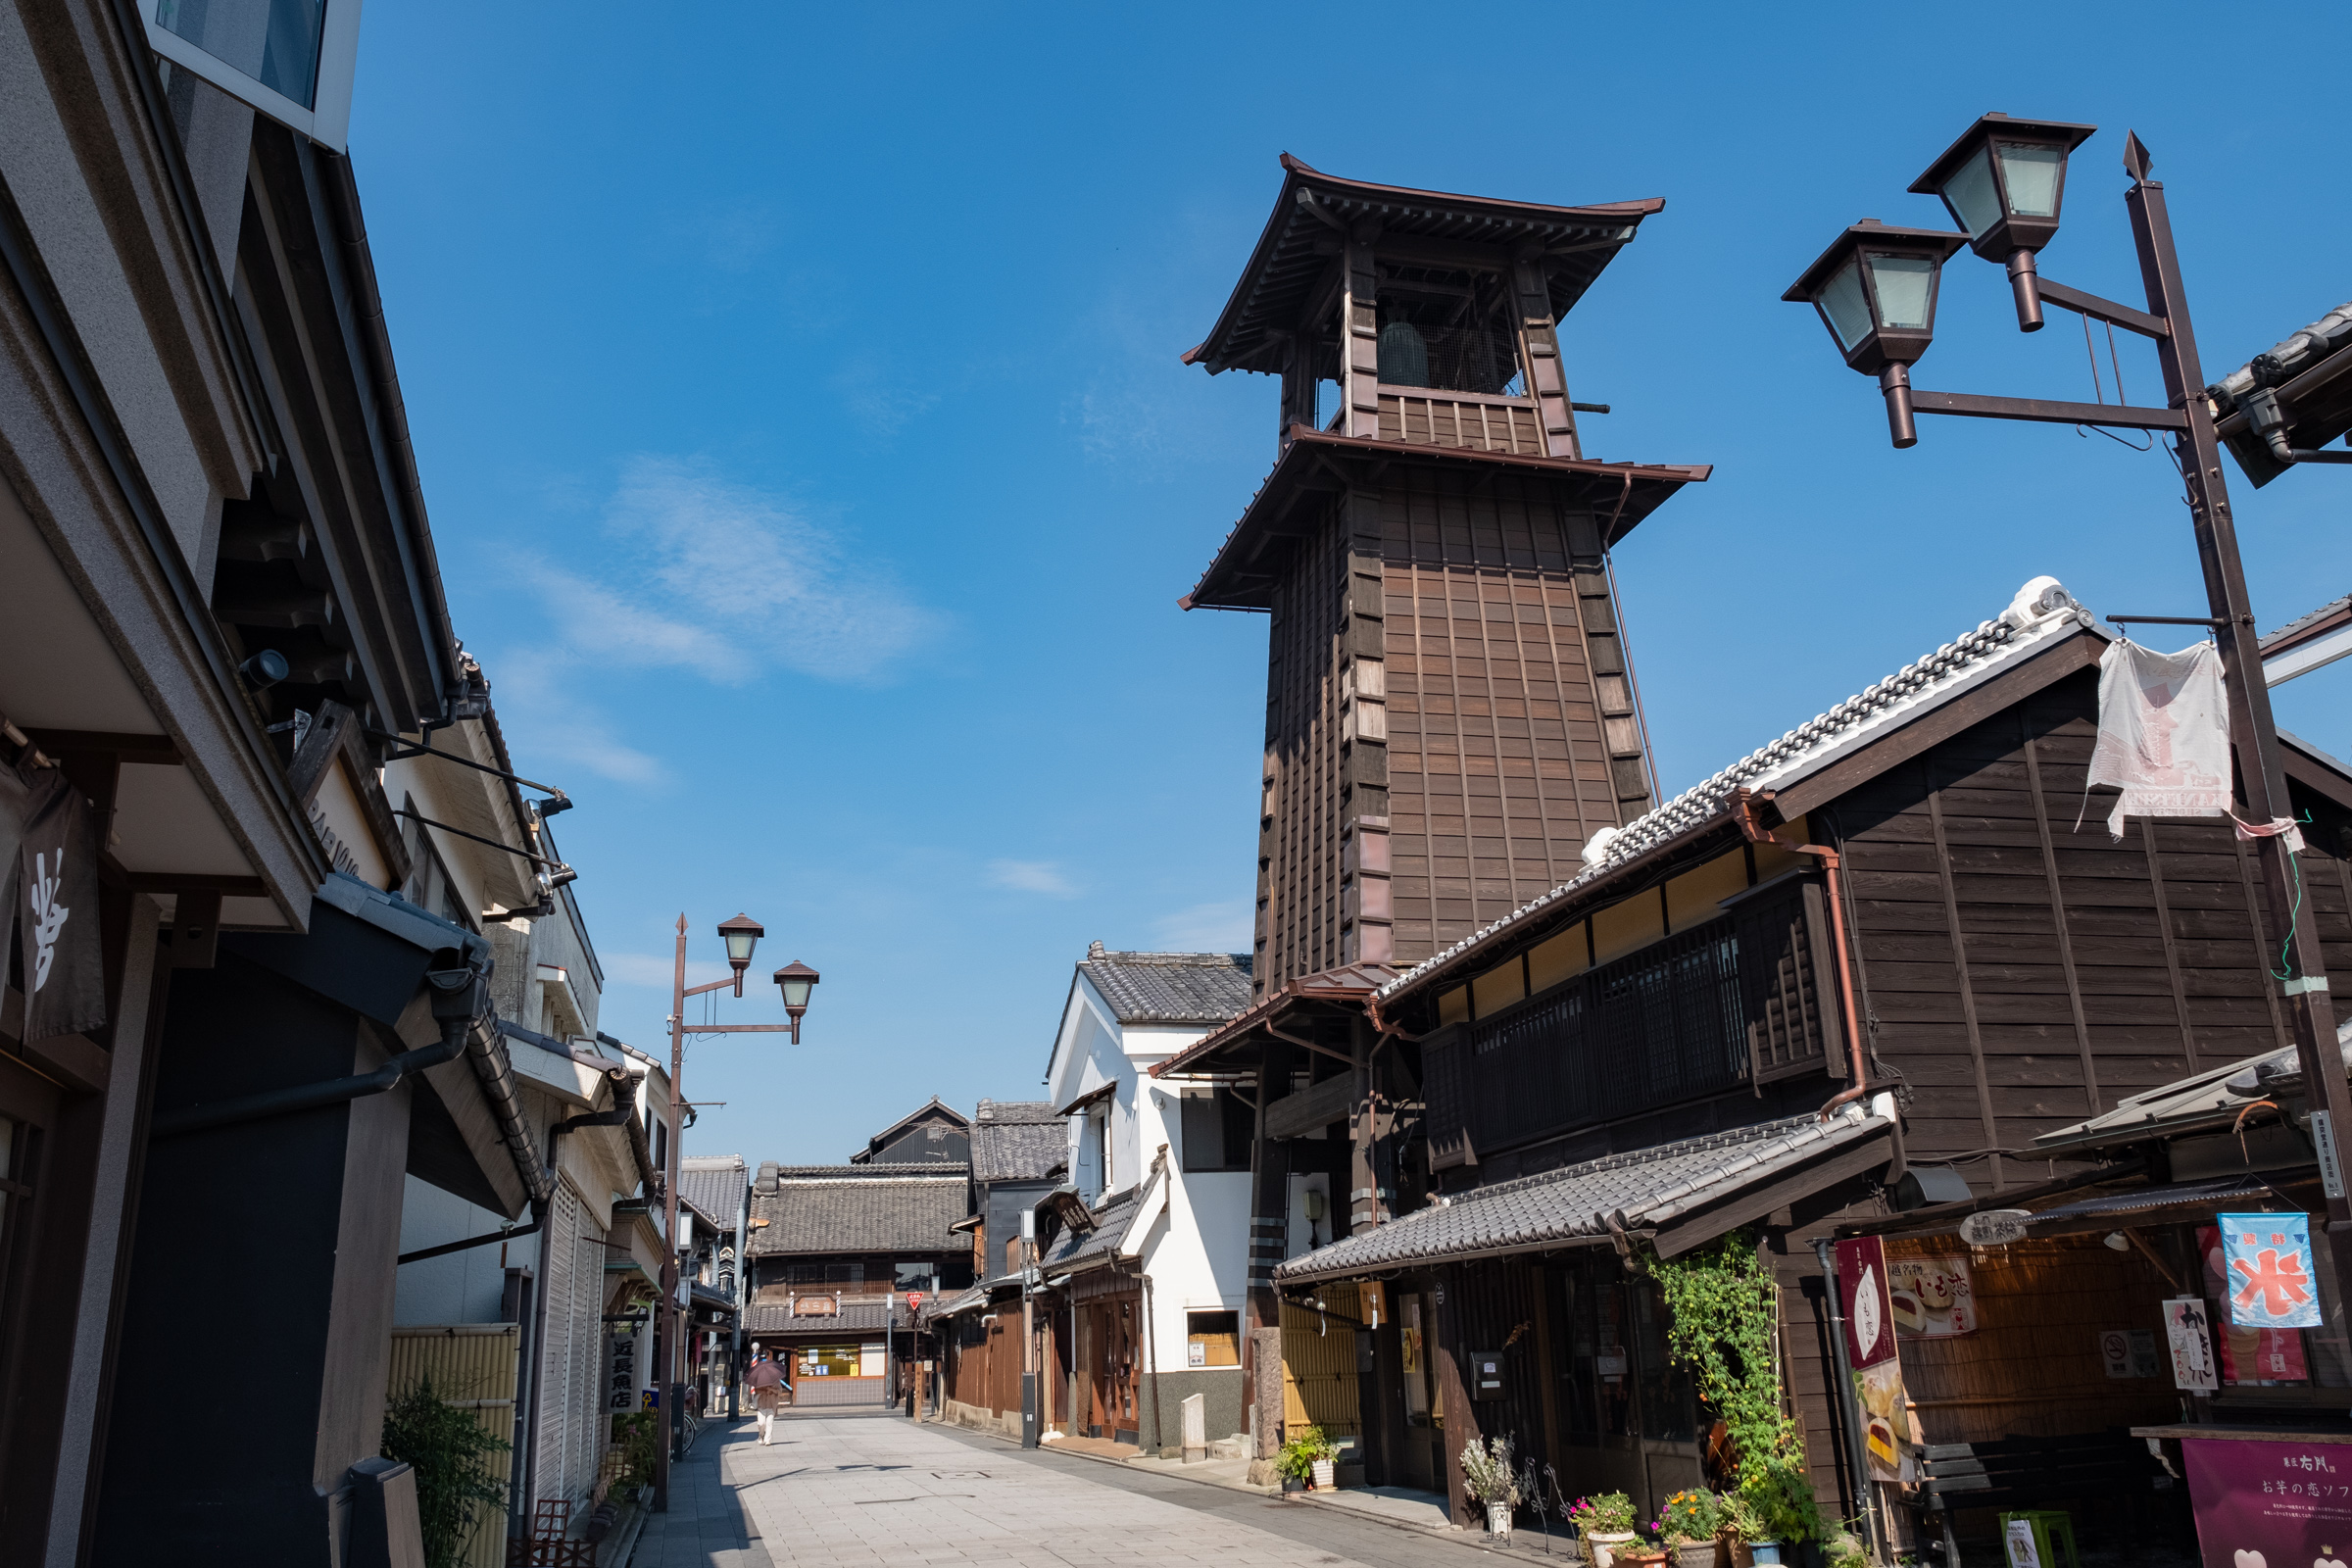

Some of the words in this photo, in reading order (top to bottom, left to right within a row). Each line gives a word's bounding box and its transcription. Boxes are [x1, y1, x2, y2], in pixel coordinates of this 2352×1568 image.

[1915, 1273, 1970, 1299] いも恋
[1859, 1290, 1875, 1337] いも恋
[610, 1341, 634, 1408] 近長魚店
